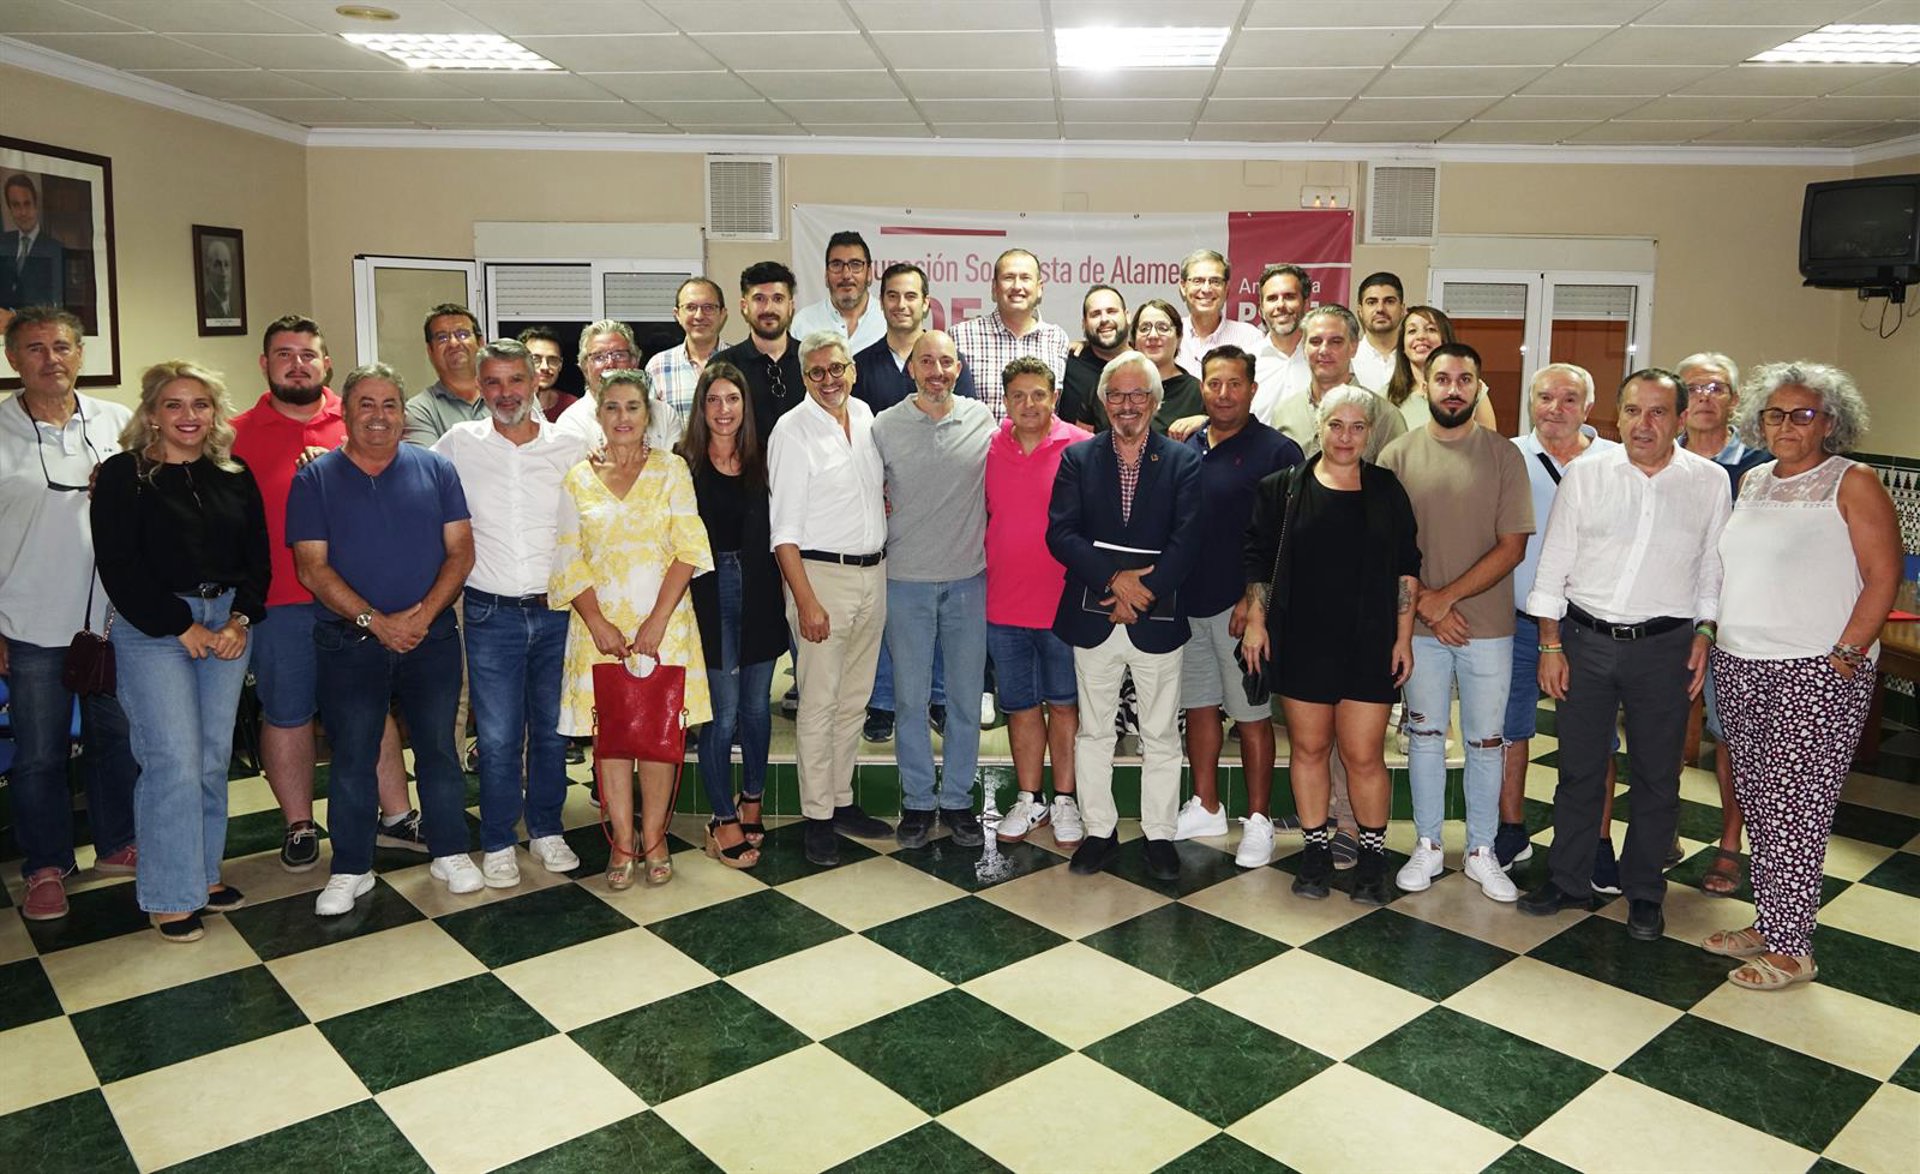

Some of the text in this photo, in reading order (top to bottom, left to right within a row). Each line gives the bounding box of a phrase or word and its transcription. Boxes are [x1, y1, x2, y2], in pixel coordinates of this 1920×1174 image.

[965, 253, 1072, 284] Sosta
[1079, 255, 1105, 284] de
[1110, 255, 1180, 285] Alame
